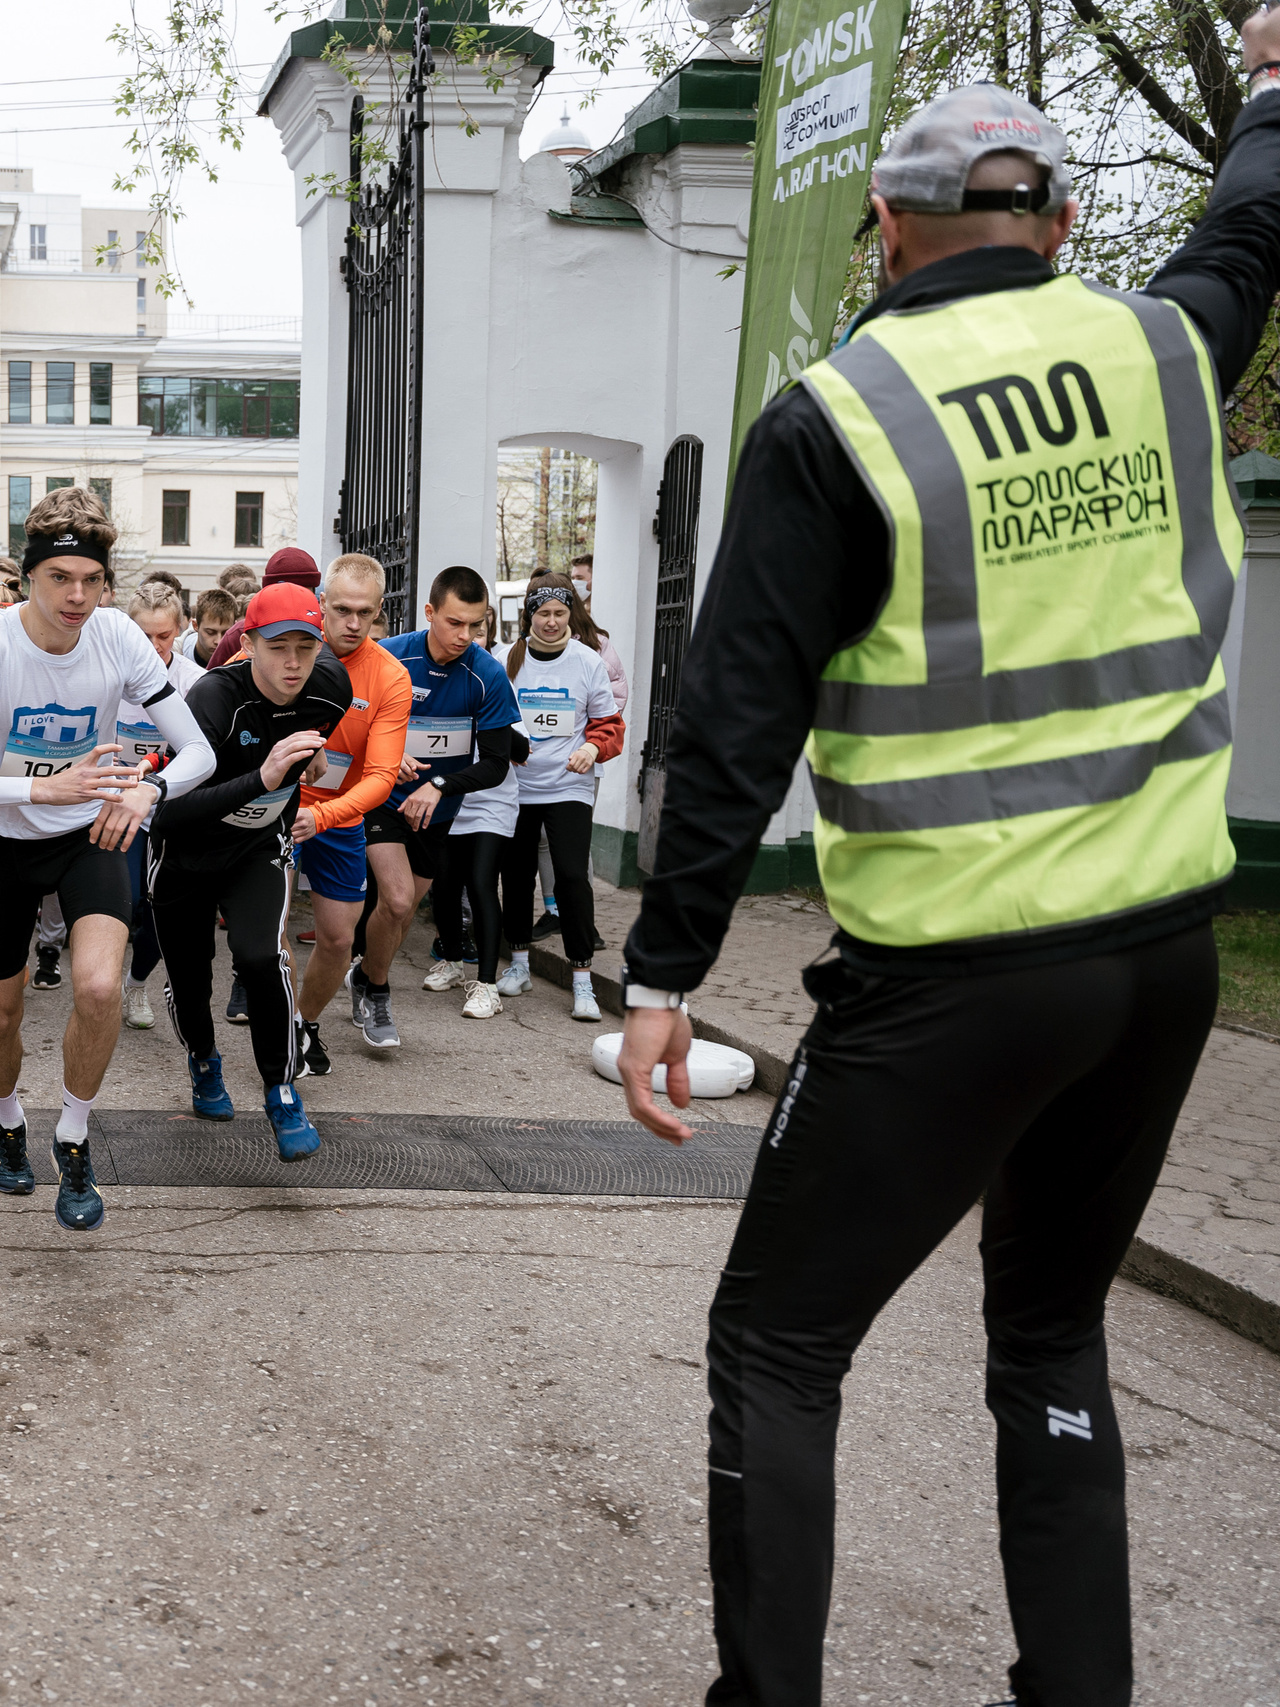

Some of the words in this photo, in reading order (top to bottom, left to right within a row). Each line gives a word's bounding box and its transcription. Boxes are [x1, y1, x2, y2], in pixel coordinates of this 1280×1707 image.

[775, 0, 877, 97] TOMSK
[973, 119, 1009, 133] Red
[1011, 118, 1041, 135] Bull
[977, 443, 1163, 514] ТОМСКИЙ
[982, 485, 1168, 552] МАРАФОН
[984, 556, 1007, 568] THE
[1010, 544, 1064, 563] GREATEST
[1067, 537, 1098, 552] SPORT
[1103, 527, 1152, 545] COMMUNITY
[31, 716, 55, 725] LOVE
[533, 713, 558, 726] 46
[134, 743, 161, 755] 67
[427, 735, 448, 748] 71
